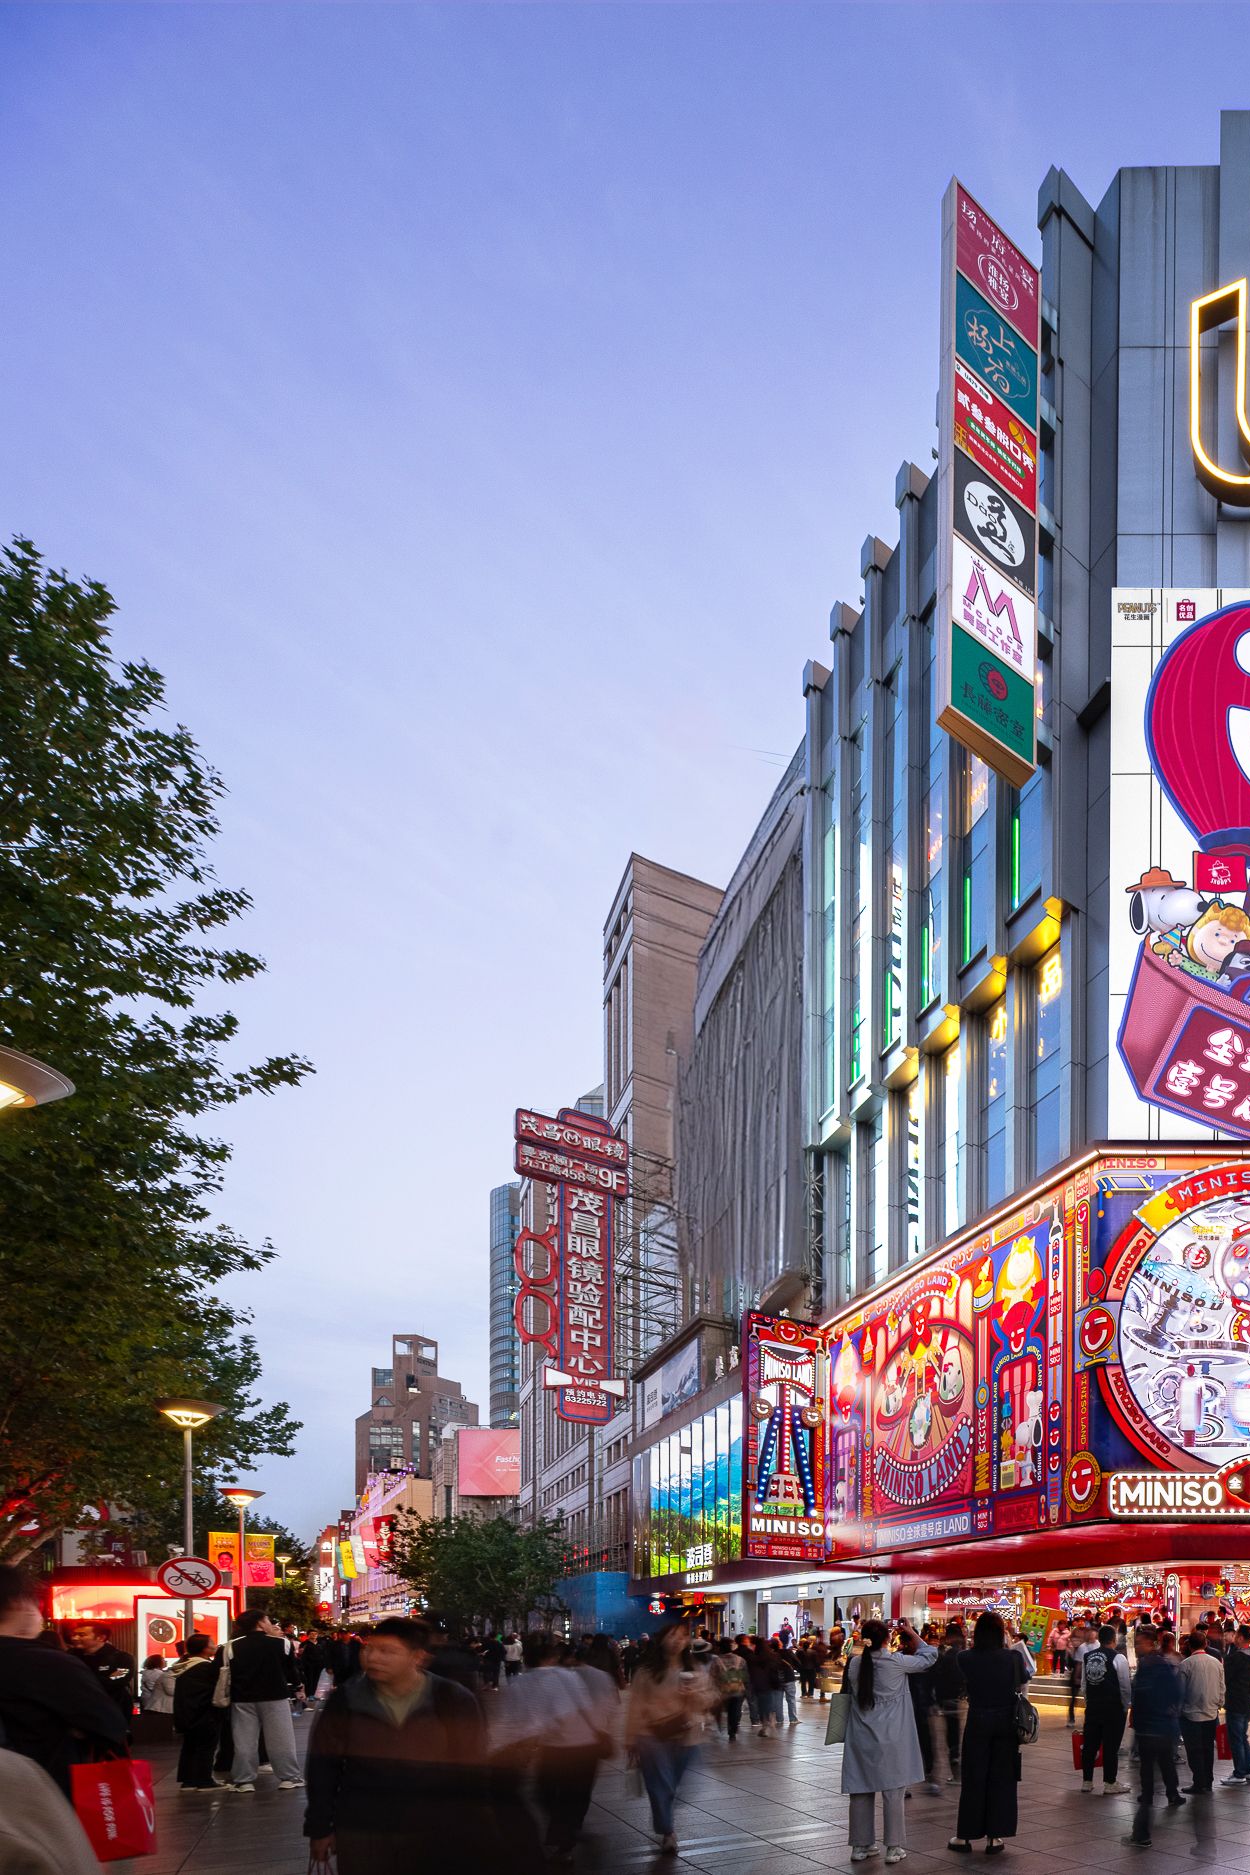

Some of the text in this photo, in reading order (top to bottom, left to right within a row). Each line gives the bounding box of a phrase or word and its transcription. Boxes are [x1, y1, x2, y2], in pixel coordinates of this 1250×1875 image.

[961, 201, 1034, 289] 扬府宴
[964, 371, 978, 388] U479
[1179, 604, 1194, 612] 名创
[1179, 611, 1194, 619] 优品
[963, 598, 1023, 653] MCLOCK
[1210, 877, 1232, 886] SNOOPY
[521, 1114, 562, 1141] 茂昌
[583, 1136, 626, 1161] 眼镜
[521, 1156, 626, 1190] 九江路458号 9F
[1098, 1157, 1157, 1170] MINISO
[1113, 1237, 1147, 1290] MINISO
[567, 1186, 605, 1375] 茂昌眼镜验配中心
[895, 1276, 949, 1312] MINISO LAND
[1050, 1294, 1061, 1304] MINI
[1027, 1345, 1042, 1361] MINISO
[1050, 1346, 1061, 1357] MINI
[764, 1353, 811, 1388] MINISO LAND
[995, 1350, 1023, 1375] MINISO LAND
[573, 1376, 599, 1387] VIP
[565, 1388, 607, 1401] 预约电话
[565, 1395, 607, 1407] 63225722
[1111, 1371, 1171, 1455] MINISO LAND
[879, 1456, 923, 1500] MINISO
[928, 1437, 965, 1491] LAND
[1228, 1476, 1242, 1490] 全
[1119, 1481, 1223, 1507] MINISO
[977, 1511, 988, 1520] MINI
[751, 1517, 824, 1537] MINISO
[877, 1524, 905, 1545] MINISO
[906, 1520, 943, 1540] 全球壹号店
[943, 1515, 969, 1533] LAND
